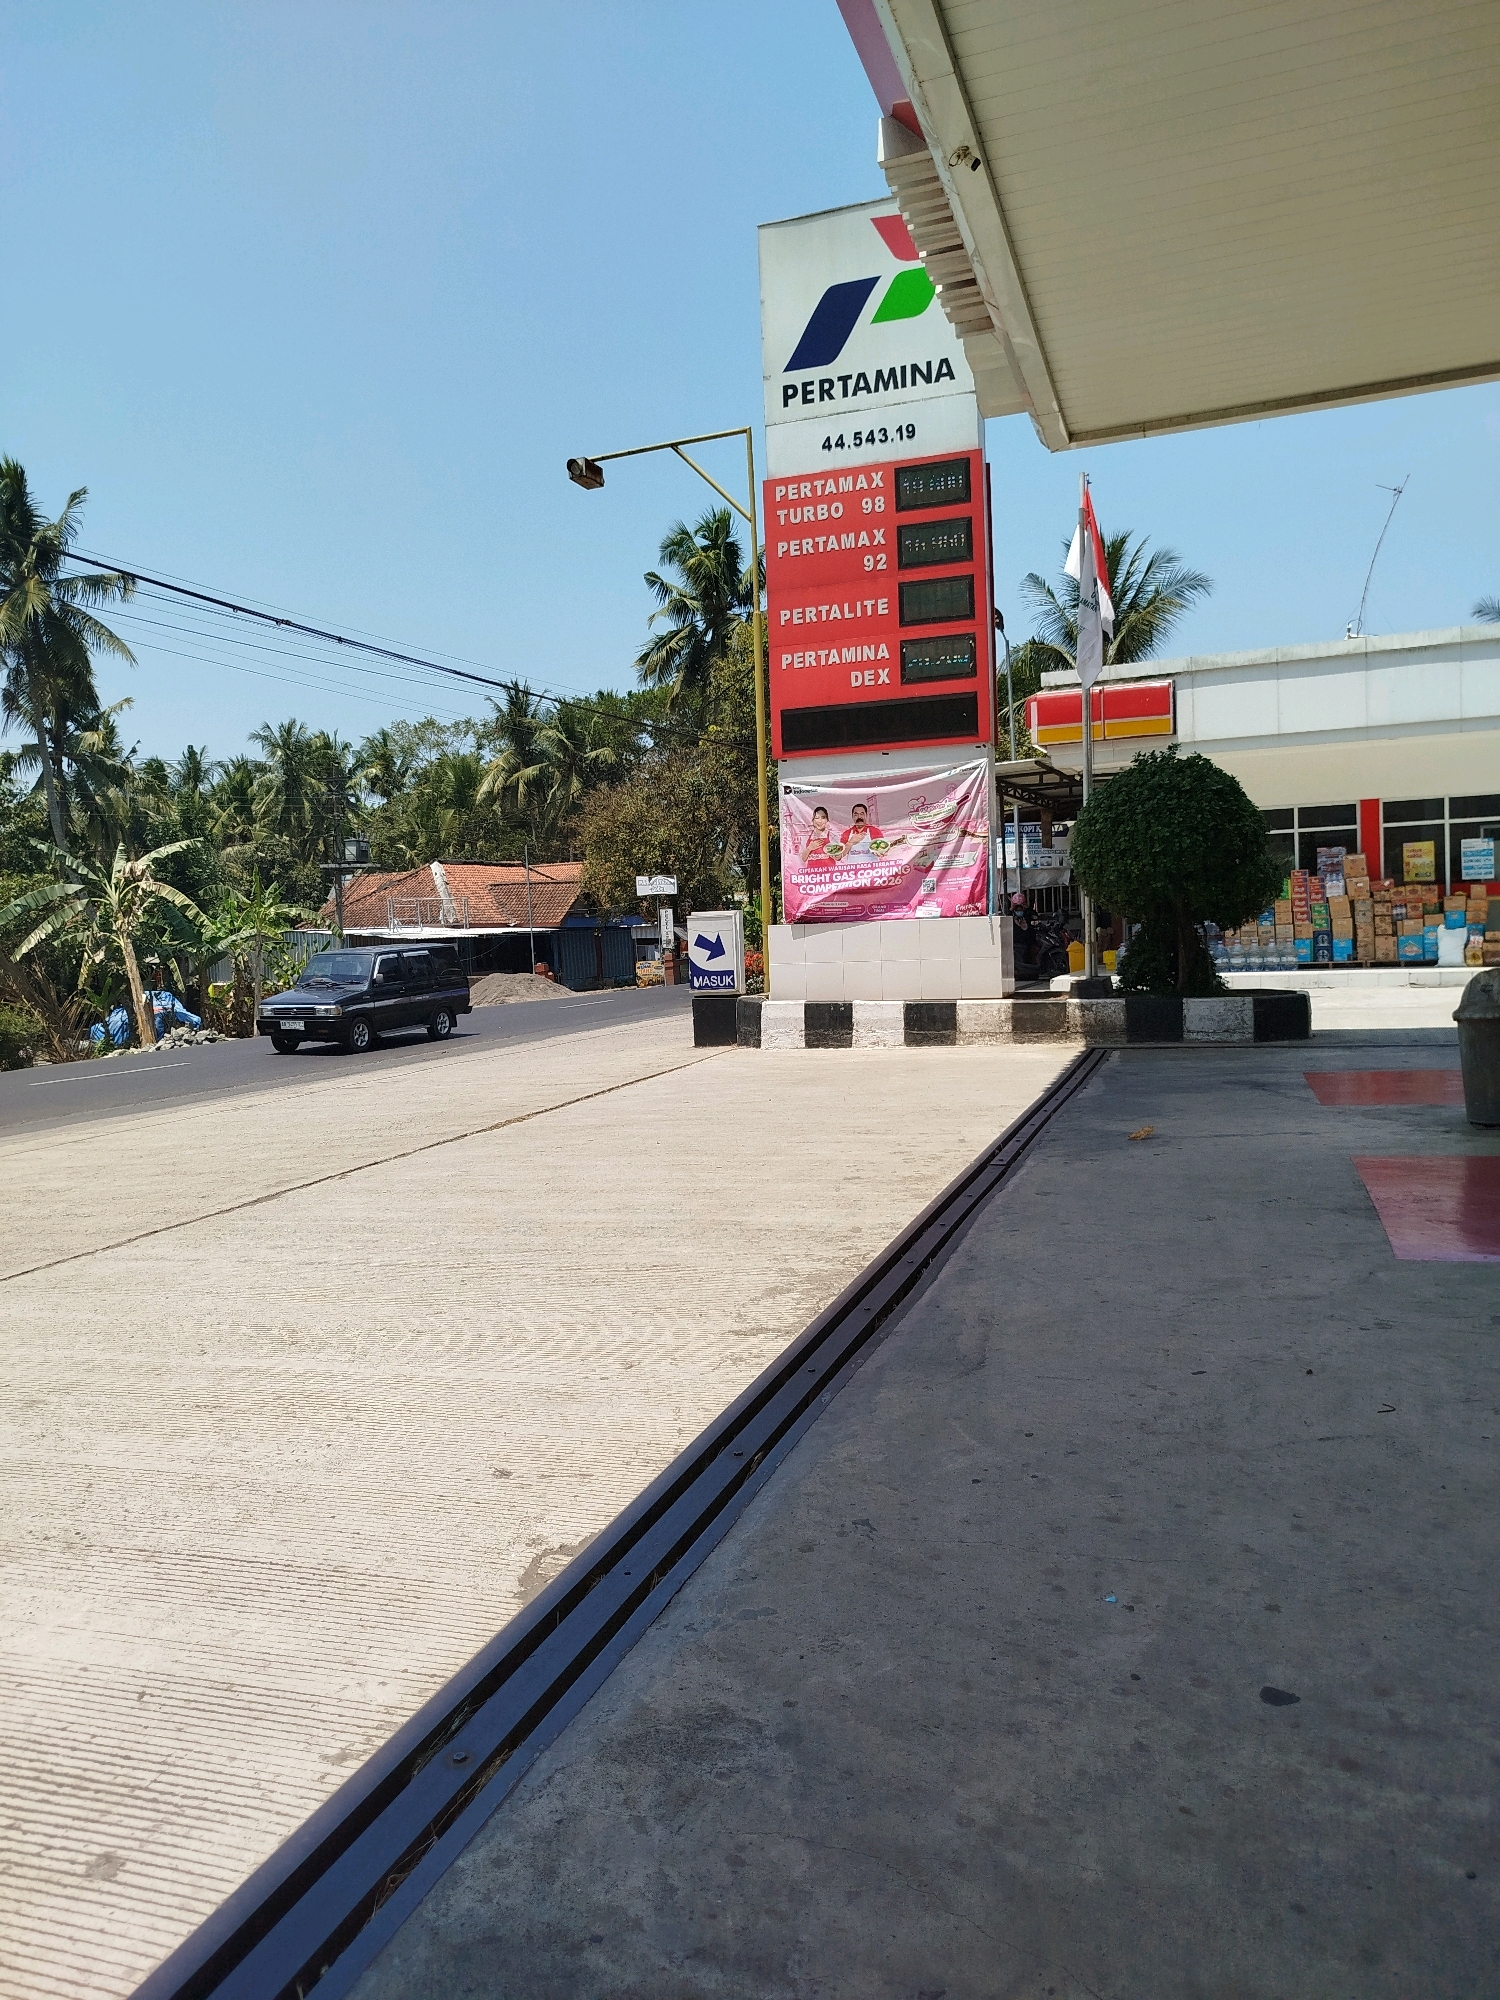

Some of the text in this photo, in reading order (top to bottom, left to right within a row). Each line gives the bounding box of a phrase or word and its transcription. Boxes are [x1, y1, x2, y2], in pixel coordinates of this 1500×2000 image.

[782, 357, 956, 408] PERTAMINA
[821, 423, 917, 452] 44.543.19
[775, 471, 885, 502] PERTAMAX
[777, 497, 886, 526] TURBO 98
[777, 529, 887, 558] PERTAMAX
[863, 554, 888, 571] 92
[780, 598, 890, 626] PERTALITE
[781, 643, 891, 670] PERTAMINA
[850, 668, 891, 688] DEX
[791, 864, 911, 884] BRIGHT GAS COOKING
[873, 876, 903, 887] 2026
[693, 975, 734, 987] MASUK
